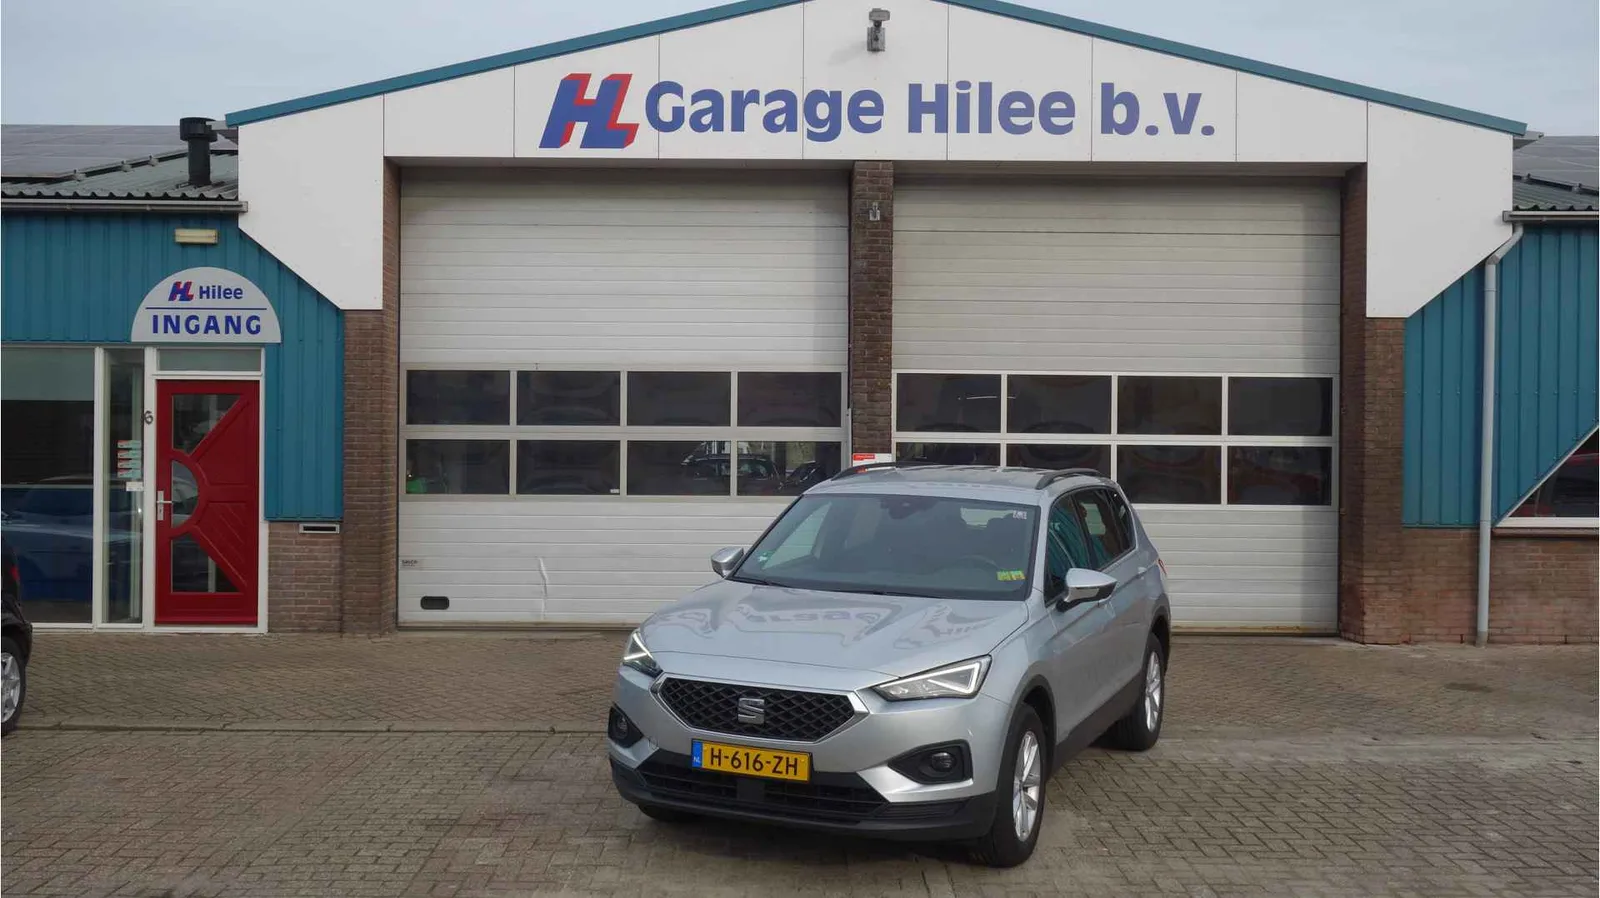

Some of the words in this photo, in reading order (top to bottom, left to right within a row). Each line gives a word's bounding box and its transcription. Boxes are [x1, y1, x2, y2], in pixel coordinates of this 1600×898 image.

[645, 80, 884, 143] Garage
[908, 80, 1076, 136] Hilee
[1100, 82, 1216, 136] b.v.
[199, 285, 244, 300] Hilee
[152, 314, 261, 335] INGANG
[143, 410, 154, 426] 6
[710, 747, 798, 776] H-616-ZH
